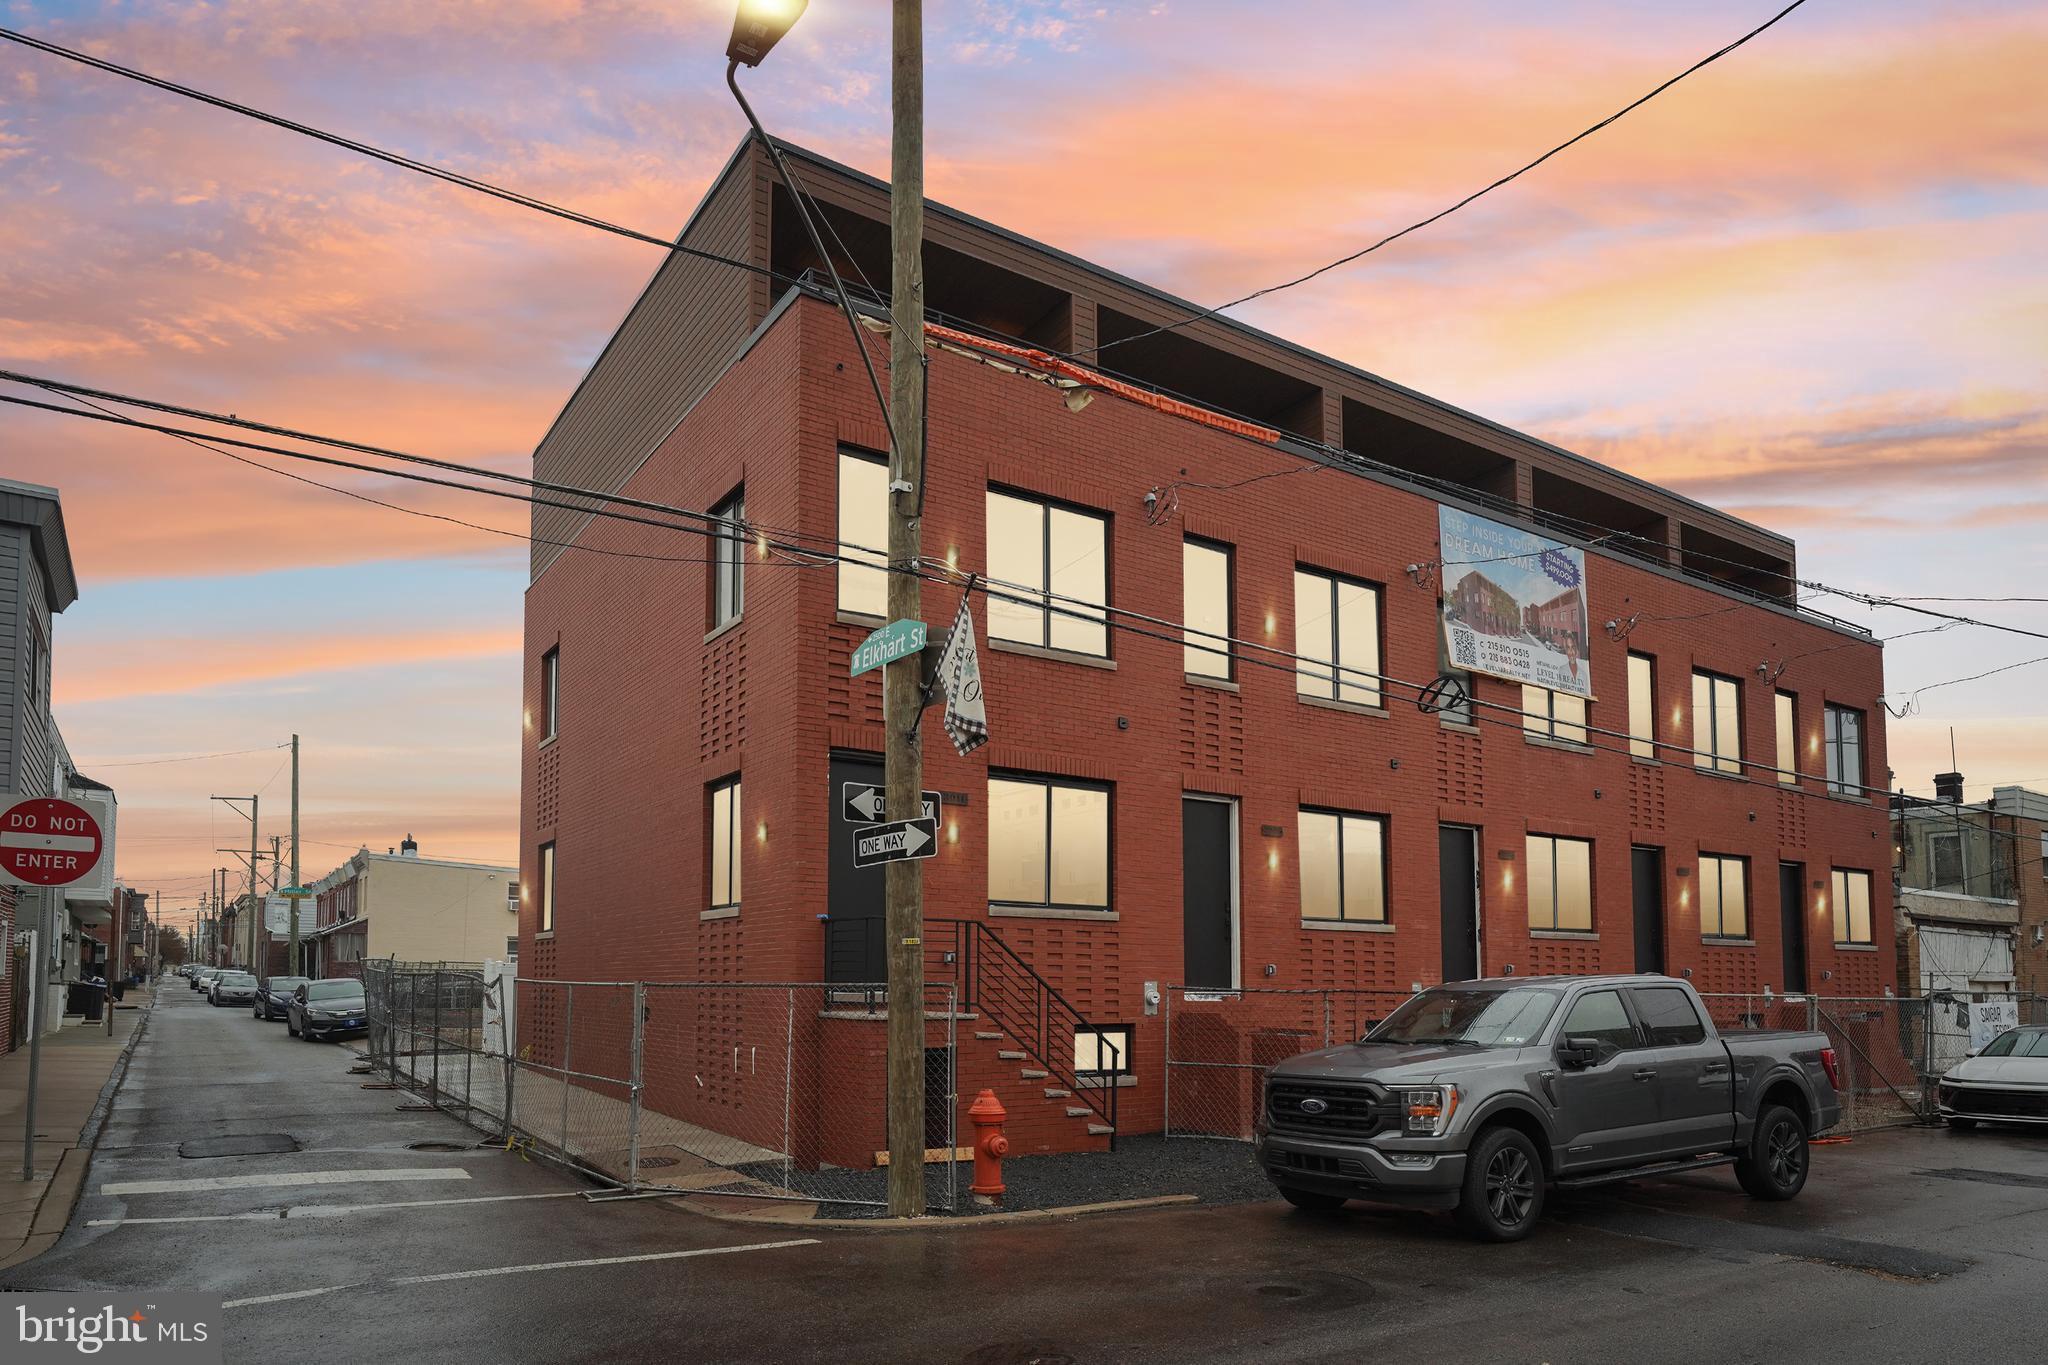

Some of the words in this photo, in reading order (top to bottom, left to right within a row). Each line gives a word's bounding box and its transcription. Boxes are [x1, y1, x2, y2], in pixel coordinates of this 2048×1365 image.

[1445, 517, 1468, 533] STEP
[1472, 525, 1504, 545] INSIDE
[1508, 536, 1534, 553] YOUR
[1445, 532, 1493, 560] DREAM
[1497, 548, 1536, 573] HOME
[1546, 552, 1574, 574] STARTING
[863, 633, 906, 669] Elkhart
[910, 627, 924, 649] St
[1487, 641, 1498, 651] 215
[1537, 667, 1556, 680] LEVEL
[11, 814, 37, 829] DO
[50, 816, 88, 832] NOT
[861, 838, 880, 855] ONE
[883, 833, 906, 851] WAY
[16, 853, 77, 870] ENTER
